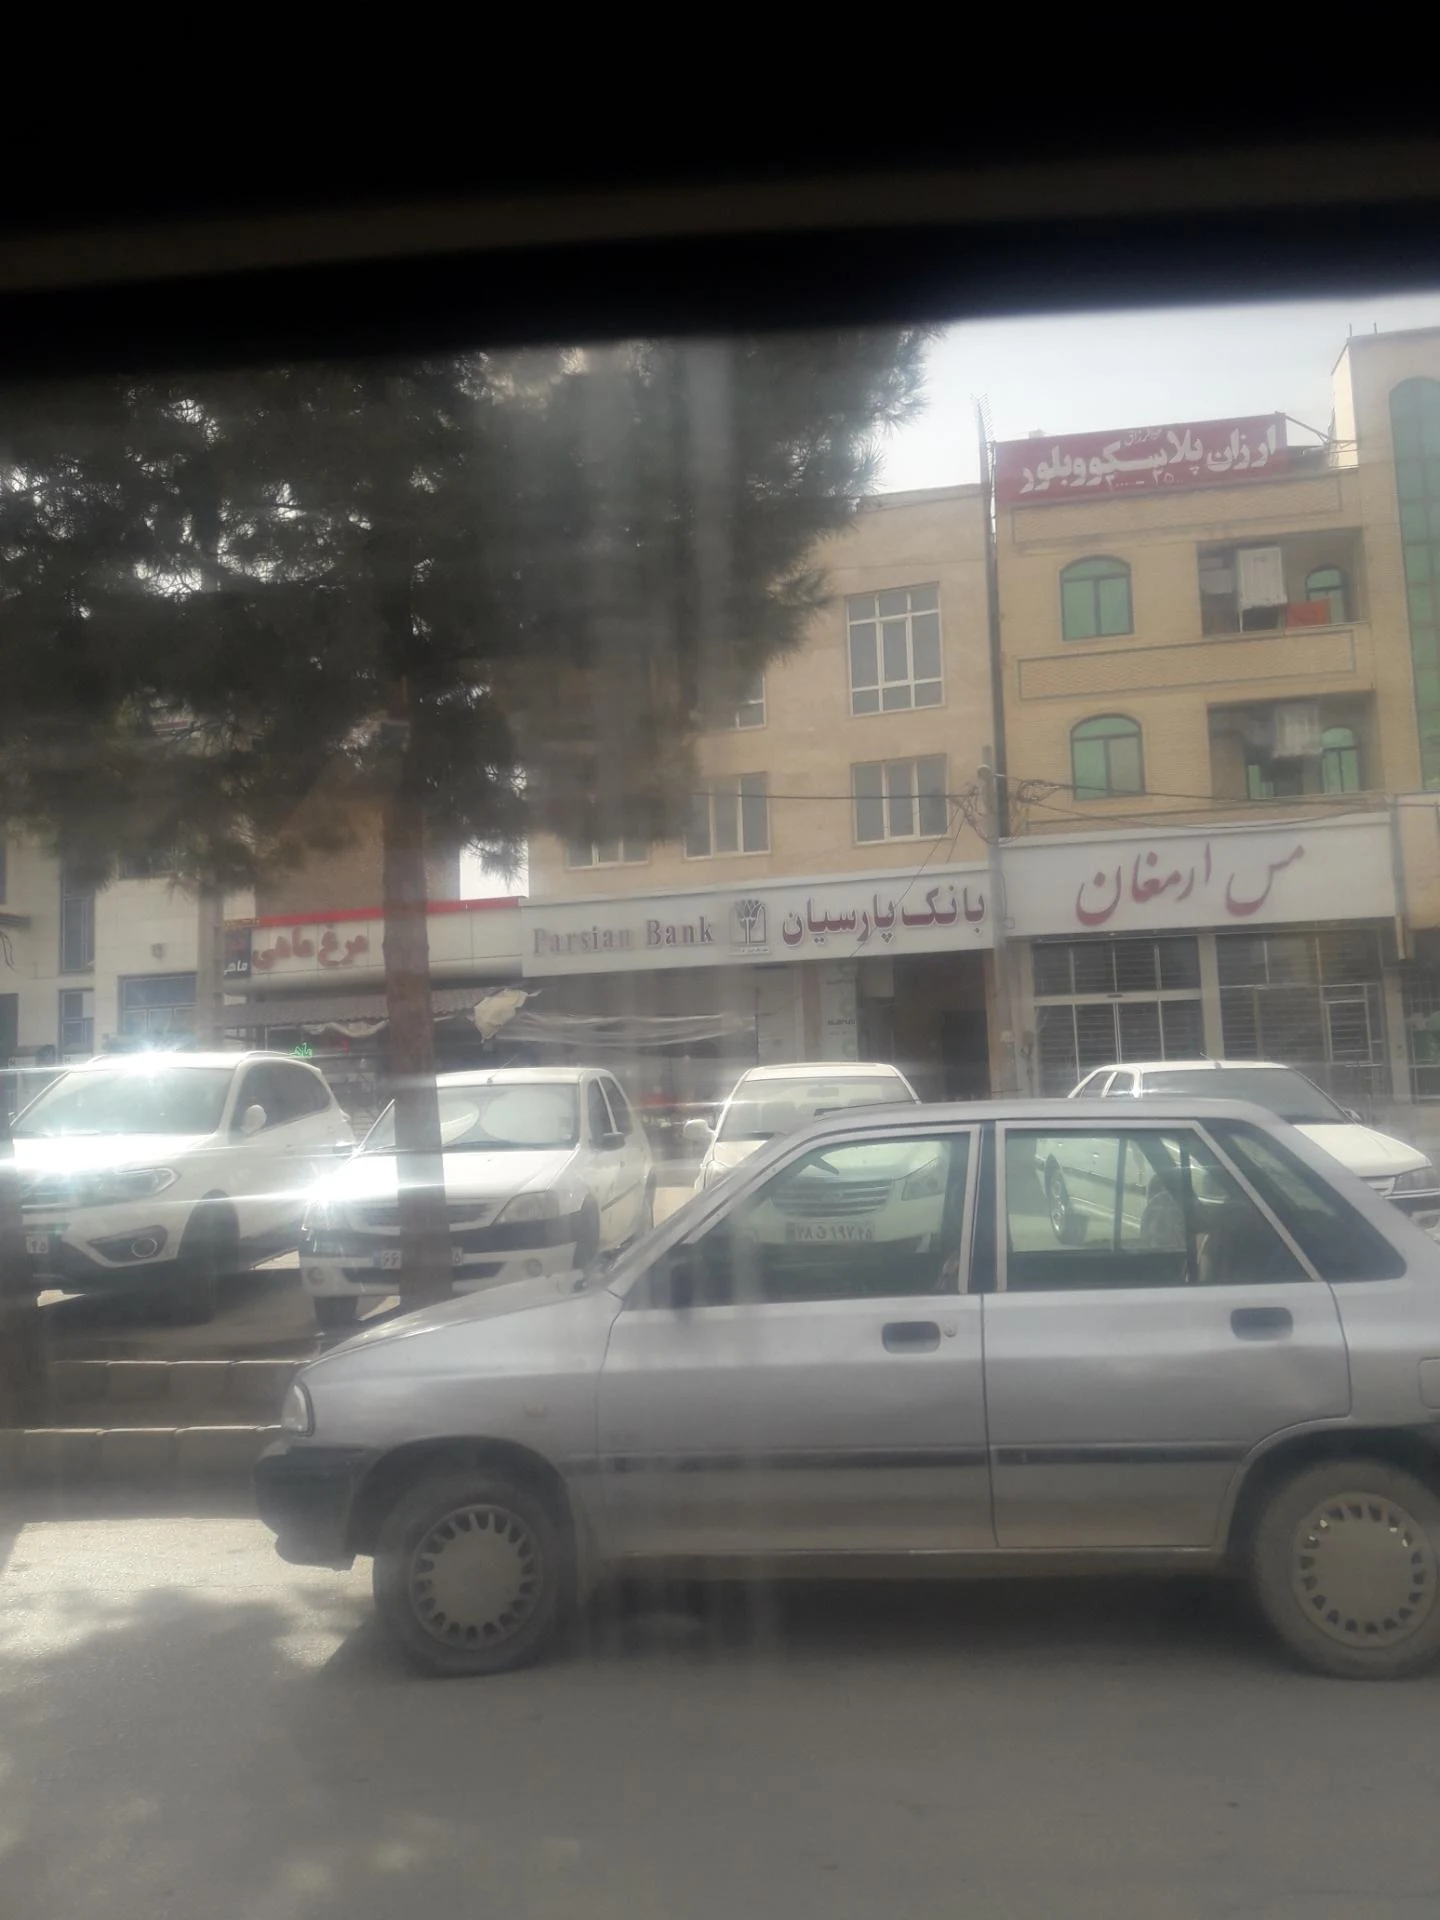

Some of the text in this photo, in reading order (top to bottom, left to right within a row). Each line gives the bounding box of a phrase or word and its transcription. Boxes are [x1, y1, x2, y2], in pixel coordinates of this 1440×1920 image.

[1019, 445, 1073, 494] بلور
[1206, 424, 1277, 473] ارزان
[1076, 841, 1306, 926] مس ارمغان
[533, 916, 714, 955] Parsian Bank
[782, 886, 986, 946] بانک پارسیان
[252, 926, 316, 971] ماهی
[319, 922, 369, 968] مرغ
